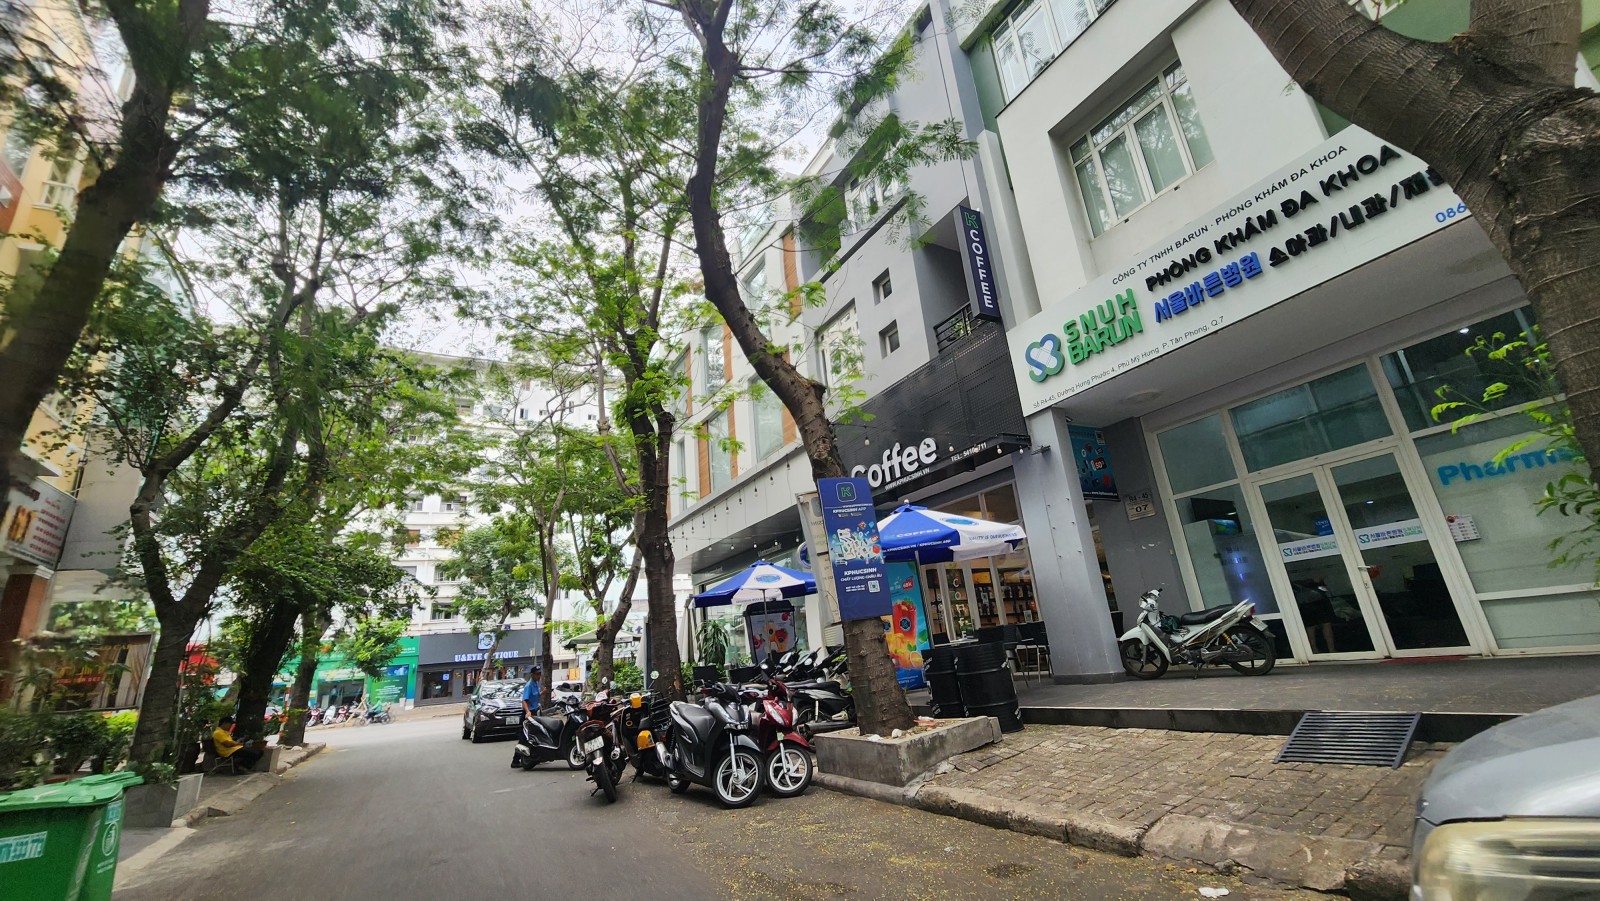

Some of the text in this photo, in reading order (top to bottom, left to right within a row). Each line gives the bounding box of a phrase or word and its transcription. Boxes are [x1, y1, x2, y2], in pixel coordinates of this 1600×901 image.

[1112, 145, 1348, 285] CÔNG TY TNHH BARUN PHÒNG KHÁM ĐA KHOA
[1145, 145, 1401, 292] PHÒNG KHÁM ĐA KHOA
[969, 229, 994, 308] COFFEE
[1155, 251, 1263, 323] 서울바른병원
[1063, 288, 1137, 343] SNUH
[1066, 311, 1144, 365] BARUN
[1211, 315, 1224, 328] Q.7
[844, 567, 877, 576] KPHUCSINH
[455, 651, 518, 662] U&EYE OTIQUE
